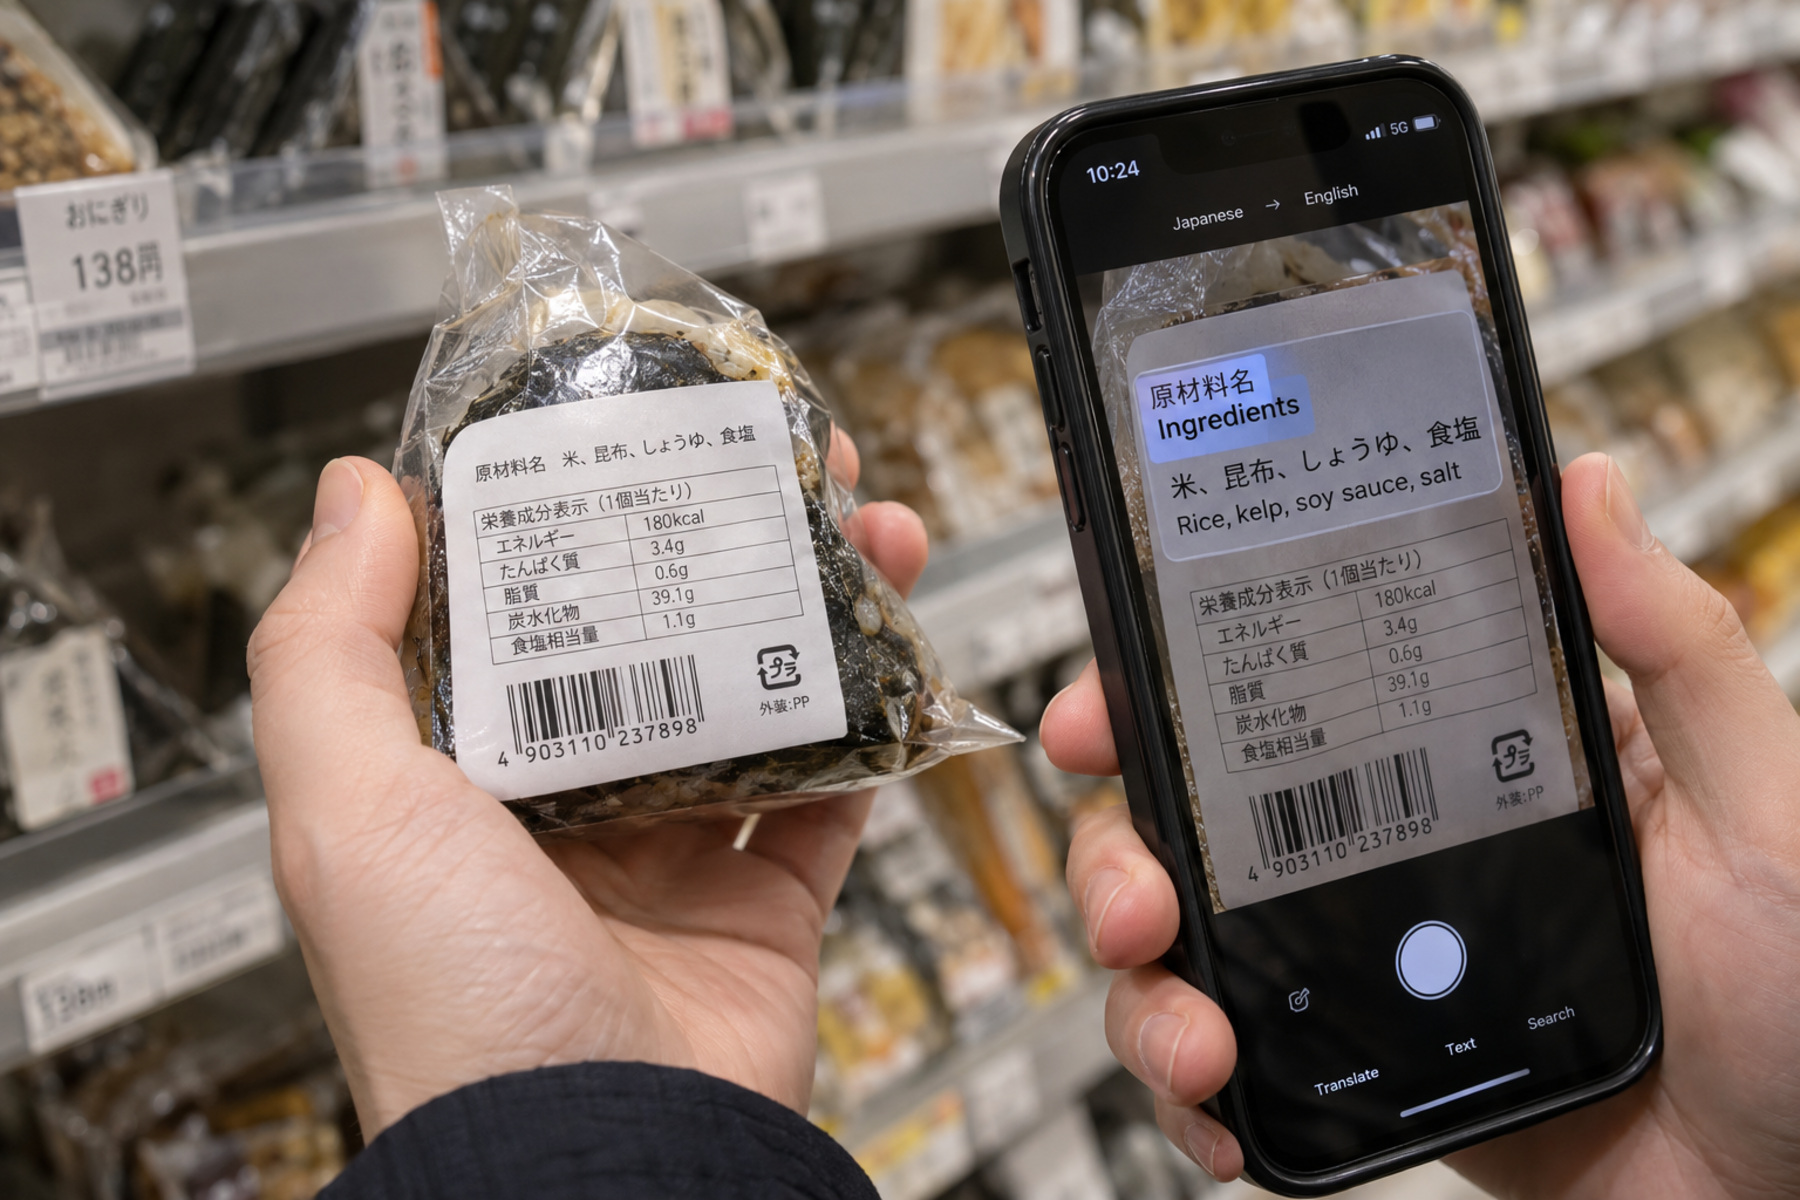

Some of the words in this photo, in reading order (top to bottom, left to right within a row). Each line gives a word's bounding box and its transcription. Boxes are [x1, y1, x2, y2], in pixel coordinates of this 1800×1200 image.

[1390, 121, 1409, 136] 5G
[1086, 159, 1140, 184] 10:24
[1304, 184, 1359, 206] English
[65, 192, 149, 230] おにぎり
[1172, 206, 1244, 231] Japanese
[72, 241, 163, 291] 138円
[1150, 368, 1255, 411] 原材料名
[1158, 396, 1301, 441] Ingredients
[475, 455, 546, 483] 原材料名
[1177, 510, 1232, 536] Rice,
[1236, 499, 1290, 525] kelp,
[1296, 490, 1334, 512] soy
[1342, 474, 1415, 503] sauce,
[1420, 461, 1462, 486] salt
[643, 509, 705, 532] 180kcal
[496, 528, 575, 554] エネルギー
[650, 538, 685, 556] 3.4g
[500, 552, 581, 581] たんぱく質
[655, 563, 689, 581] 0.6g
[504, 583, 540, 605] 脂質
[651, 587, 695, 606] 39.1g
[1375, 580, 1437, 609] 180kcal
[508, 604, 580, 631] 炭水化物
[662, 612, 696, 630] 1.1g
[1217, 614, 1301, 645] エネルギー
[1383, 616, 1418, 636] 3.4g
[511, 626, 600, 656] 食塩相当量
[1389, 644, 1423, 664] 0.6g
[1229, 680, 1266, 705] 脂質
[1387, 670, 1430, 693] 39.1g
[1235, 703, 1307, 735] 炭水化物
[1398, 699, 1432, 719] 1.1g
[498, 751, 509, 767] 4
[525, 734, 607, 763] 903110
[618, 718, 697, 746] 237898
[1240, 727, 1328, 764] 食塩相当量
[1248, 866, 1258, 882] 4
[1273, 841, 1347, 878] 903110
[1358, 817, 1432, 853] 237898
[1527, 1005, 1575, 1030] Search
[1445, 1037, 1477, 1056] Text
[1314, 1067, 1379, 1096] Translate
